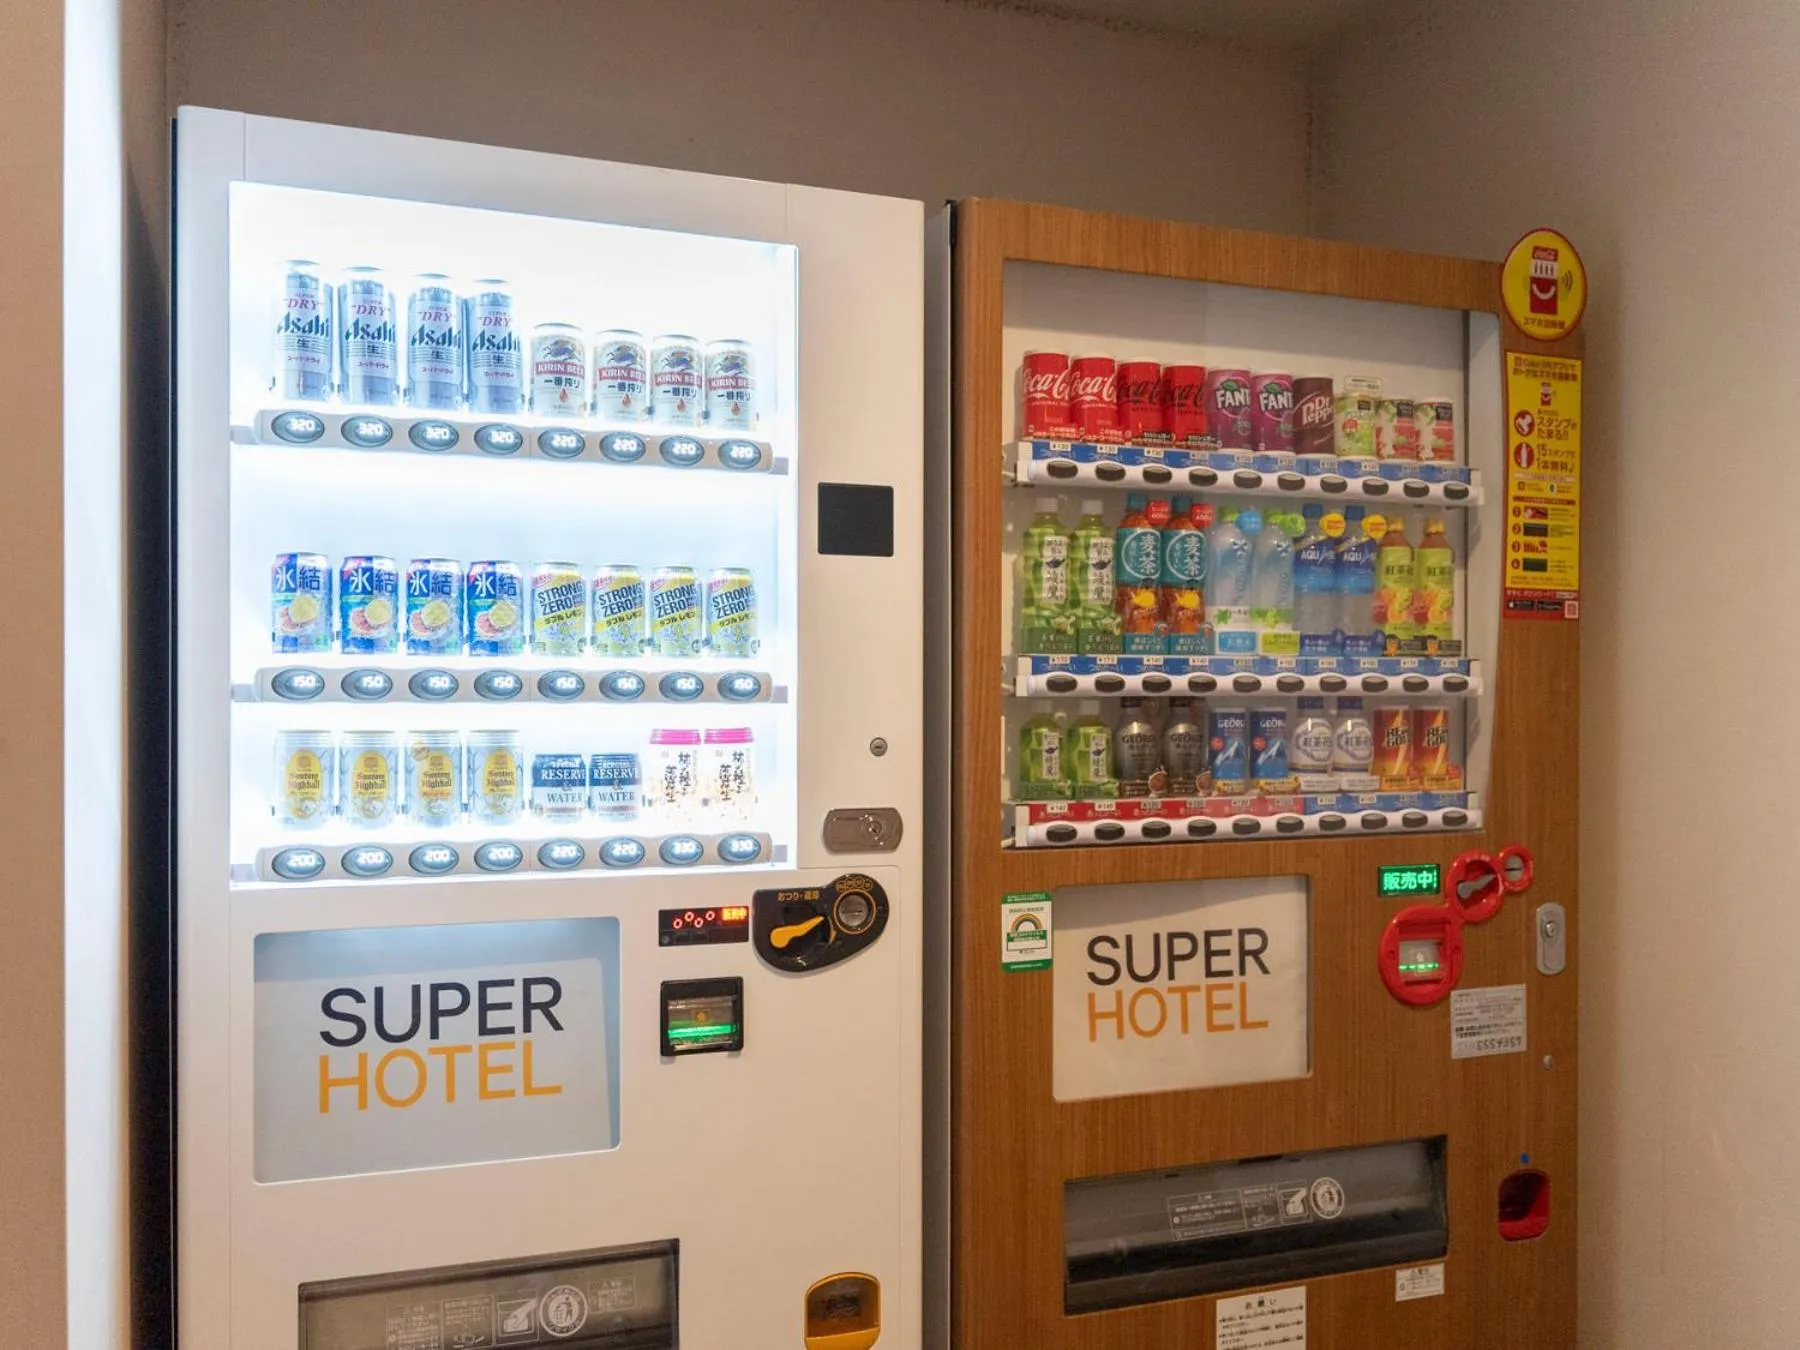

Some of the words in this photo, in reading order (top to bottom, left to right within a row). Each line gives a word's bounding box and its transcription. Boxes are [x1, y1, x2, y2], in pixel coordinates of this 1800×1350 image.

[288, 298, 317, 310] DRY
[356, 304, 385, 316] DRY
[277, 311, 329, 337] Asahi
[422, 311, 452, 322] DRY
[481, 317, 511, 327] DRY
[345, 317, 395, 342] Asahi
[411, 323, 461, 349] Asahi
[472, 328, 520, 352] Asahi
[538, 363, 566, 372] KIRIN
[601, 368, 629, 378] KIRIN
[656, 374, 684, 383] KIRIN
[710, 379, 737, 389] KIRIN
[291, 418, 315, 431] 320
[359, 423, 384, 435] 320
[426, 427, 449, 439] 320
[491, 431, 514, 443] 320
[1139, 533, 1157, 573] 麦茶
[1183, 536, 1201, 577] 麦茶
[274, 567, 321, 591] 氷結
[350, 568, 395, 594] 氷結
[410, 571, 452, 596] 氷結
[474, 571, 517, 597] 氷結
[537, 581, 582, 603] STRONG
[599, 583, 642, 606] STRONG
[654, 584, 696, 607] STRONG
[713, 586, 755, 608] STRONG
[541, 597, 573, 615] ZERO
[602, 598, 633, 618] ZERO
[656, 599, 686, 618] ZERO
[716, 600, 746, 619] ZERO
[598, 791, 635, 803] WATER
[288, 854, 316, 867] 200
[358, 851, 384, 864] 200
[425, 850, 450, 862] 200
[489, 847, 514, 860] 200
[1383, 871, 1433, 891] 販売中
[1086, 927, 1271, 986] SUPER
[319, 976, 564, 1047] SUPER
[1087, 981, 1270, 1043] HOTEL
[318, 1040, 563, 1114] HOTEL
